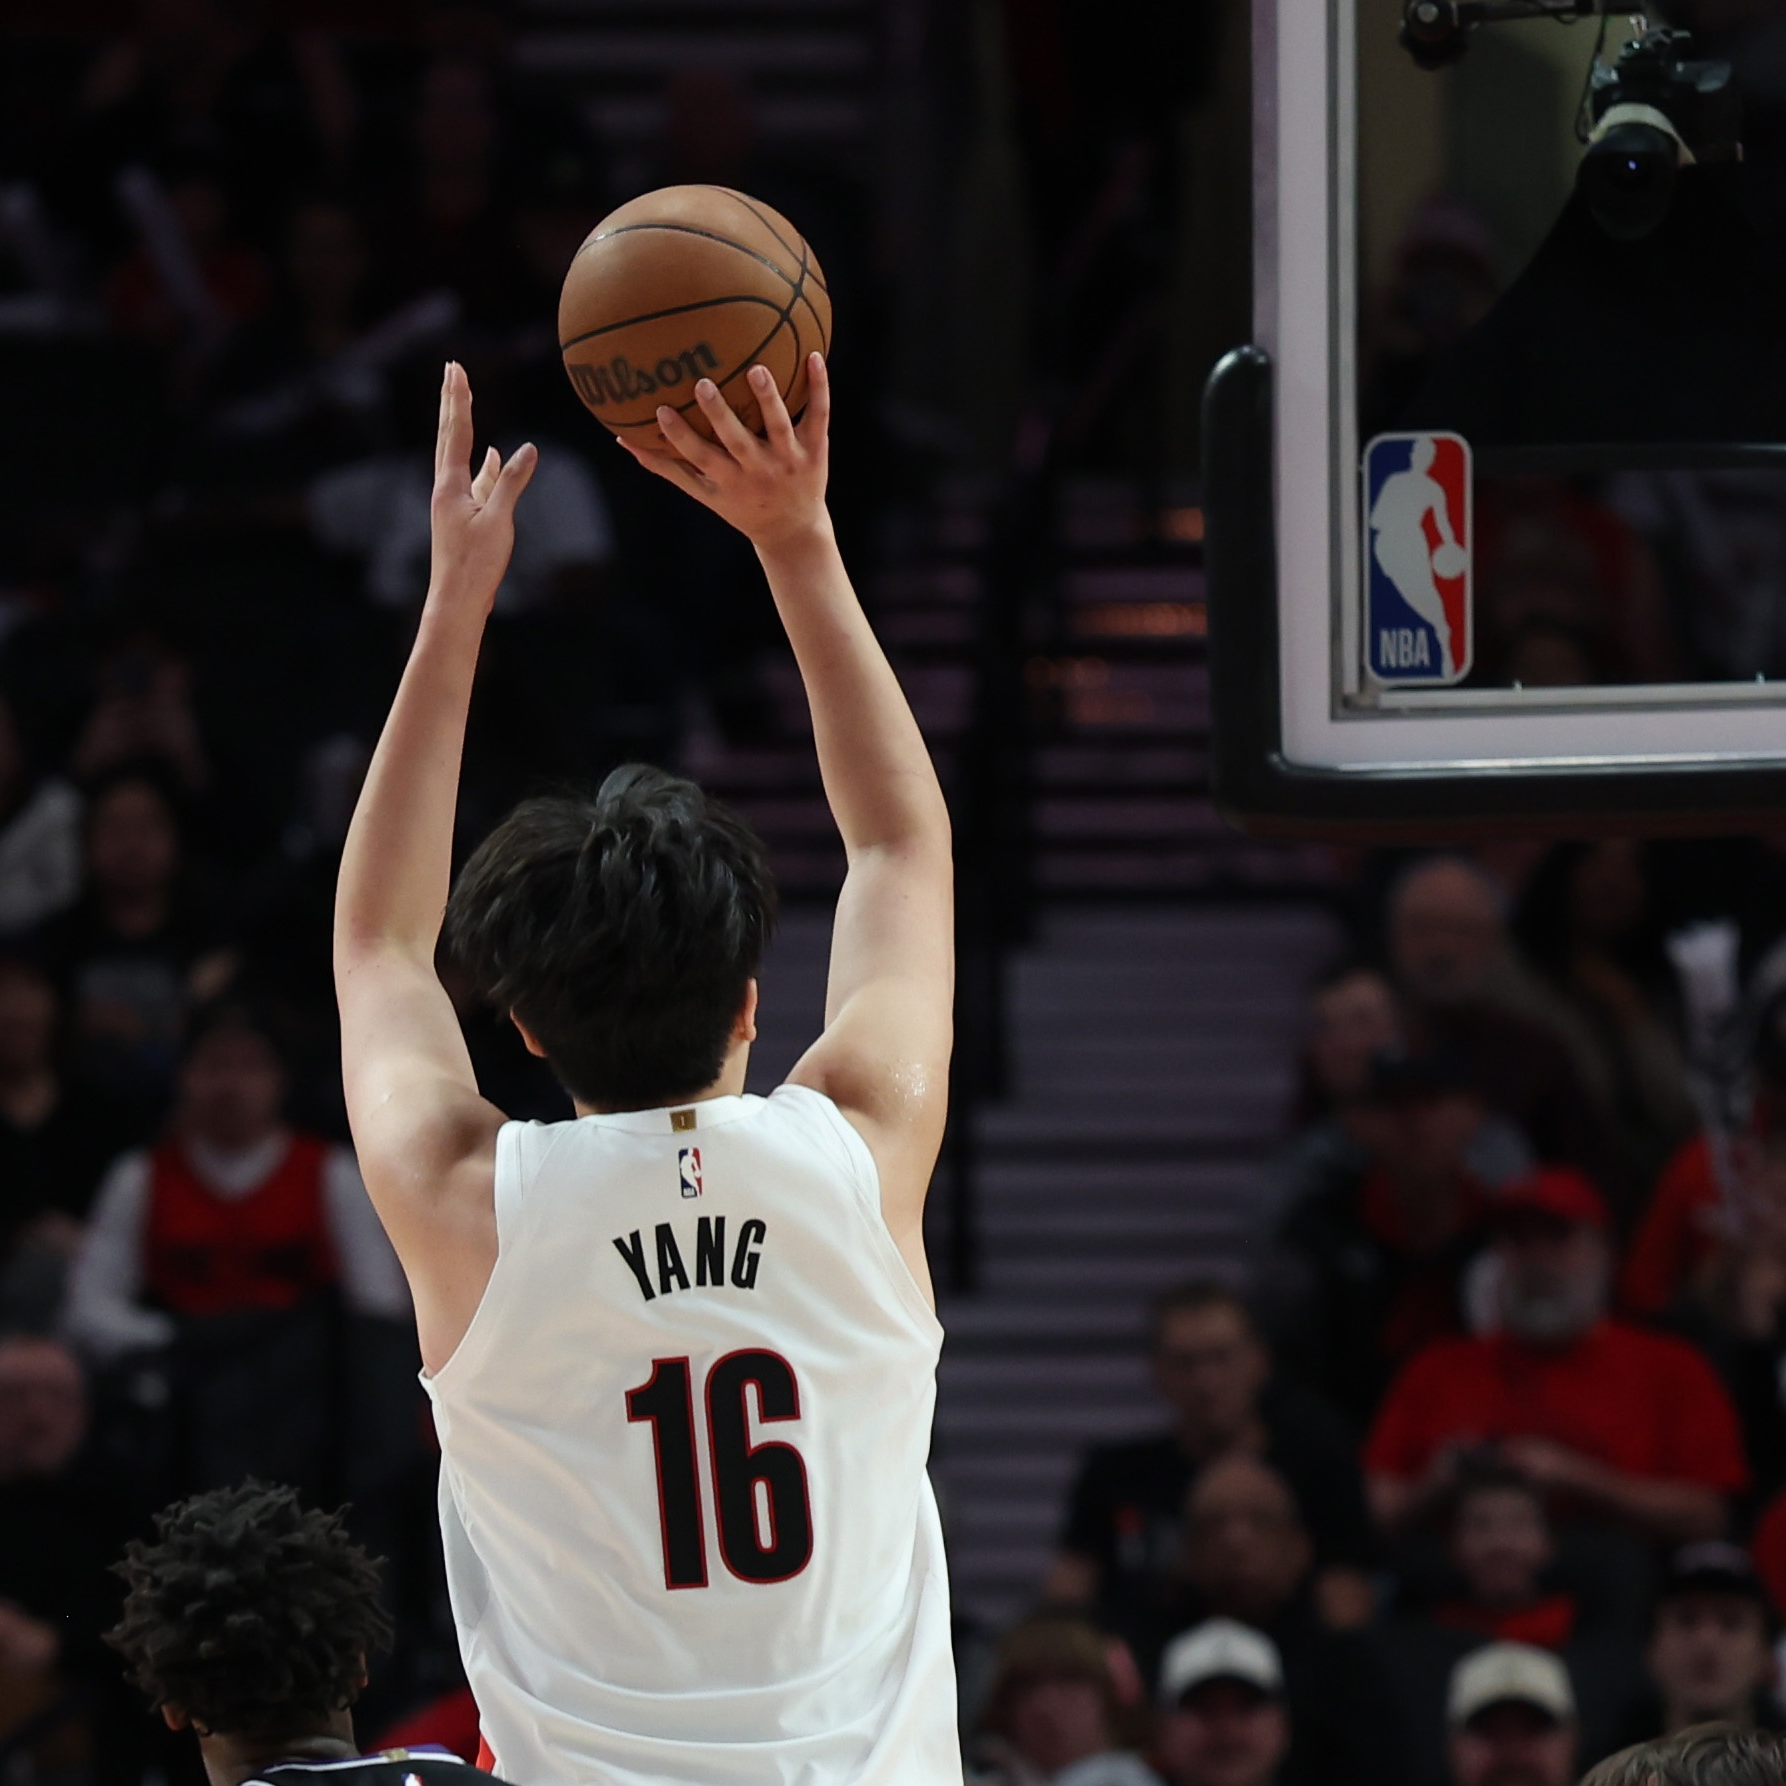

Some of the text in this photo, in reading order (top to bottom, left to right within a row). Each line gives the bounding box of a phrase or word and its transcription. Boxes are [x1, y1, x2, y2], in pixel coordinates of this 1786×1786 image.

[568, 340, 720, 406] Wilson
[1379, 626, 1431, 669] NBA
[612, 1216, 767, 1301] YANG
[624, 1348, 814, 1591] 16
